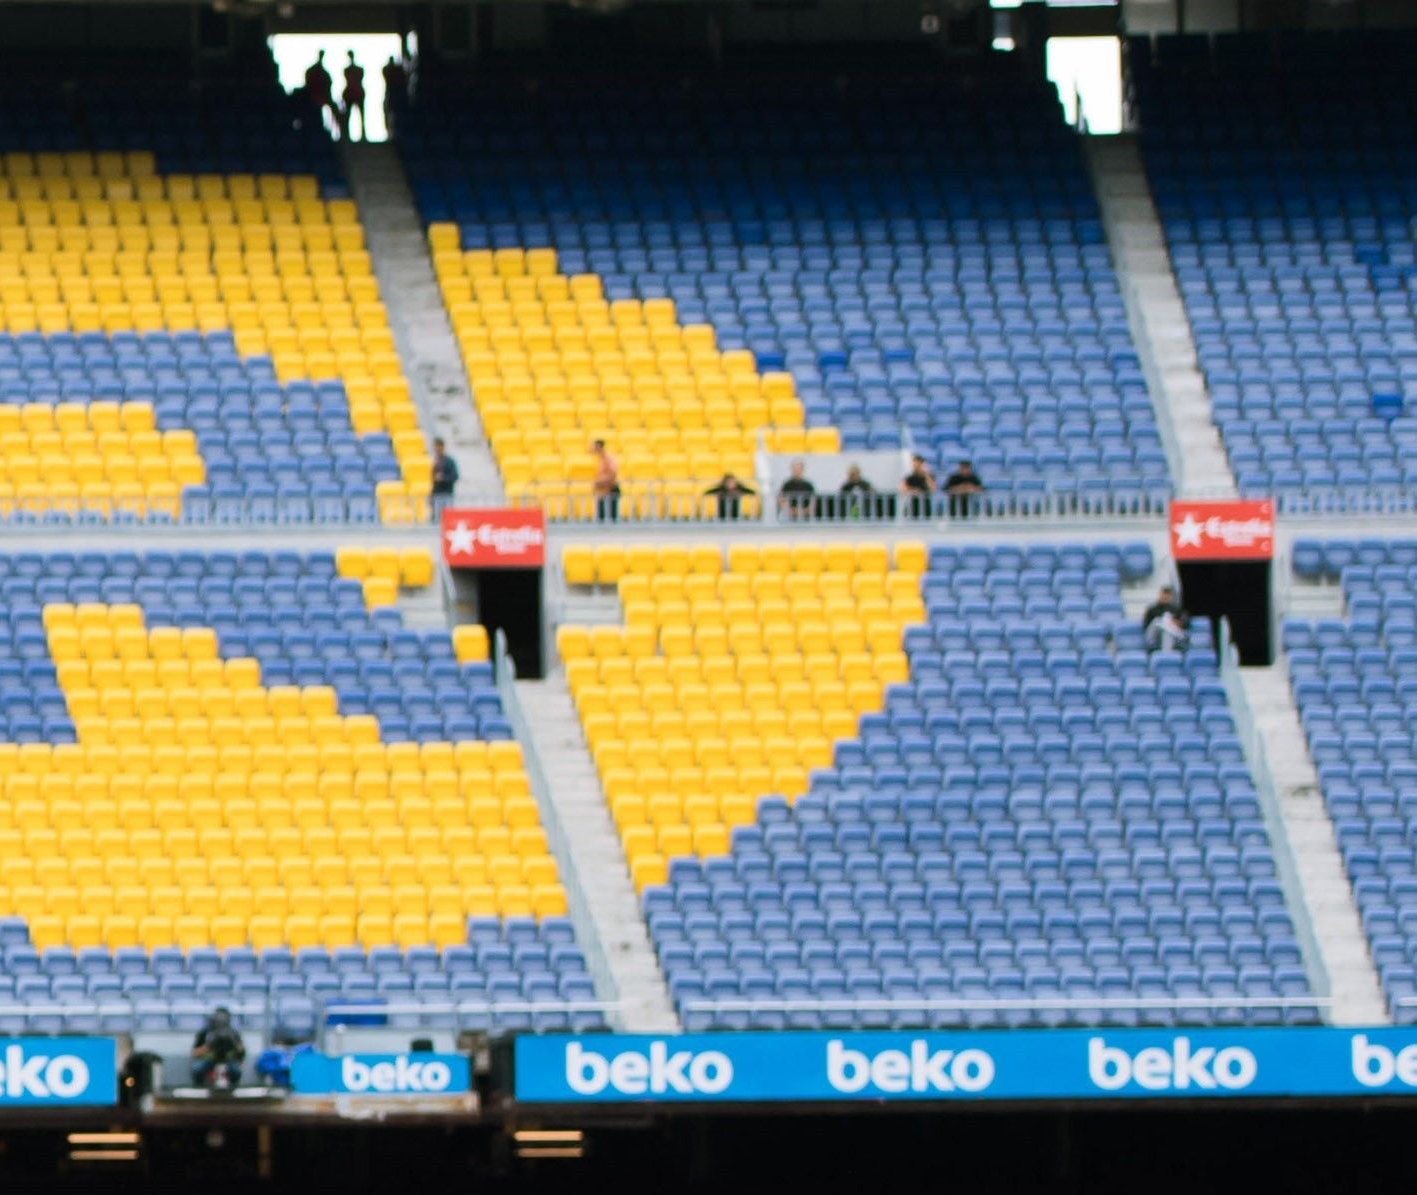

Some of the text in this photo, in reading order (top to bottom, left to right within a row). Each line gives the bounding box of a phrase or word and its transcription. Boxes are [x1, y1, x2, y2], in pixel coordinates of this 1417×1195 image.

[342, 1055, 450, 1092] beko
[566, 1035, 1417, 1094] beko beko beko be
